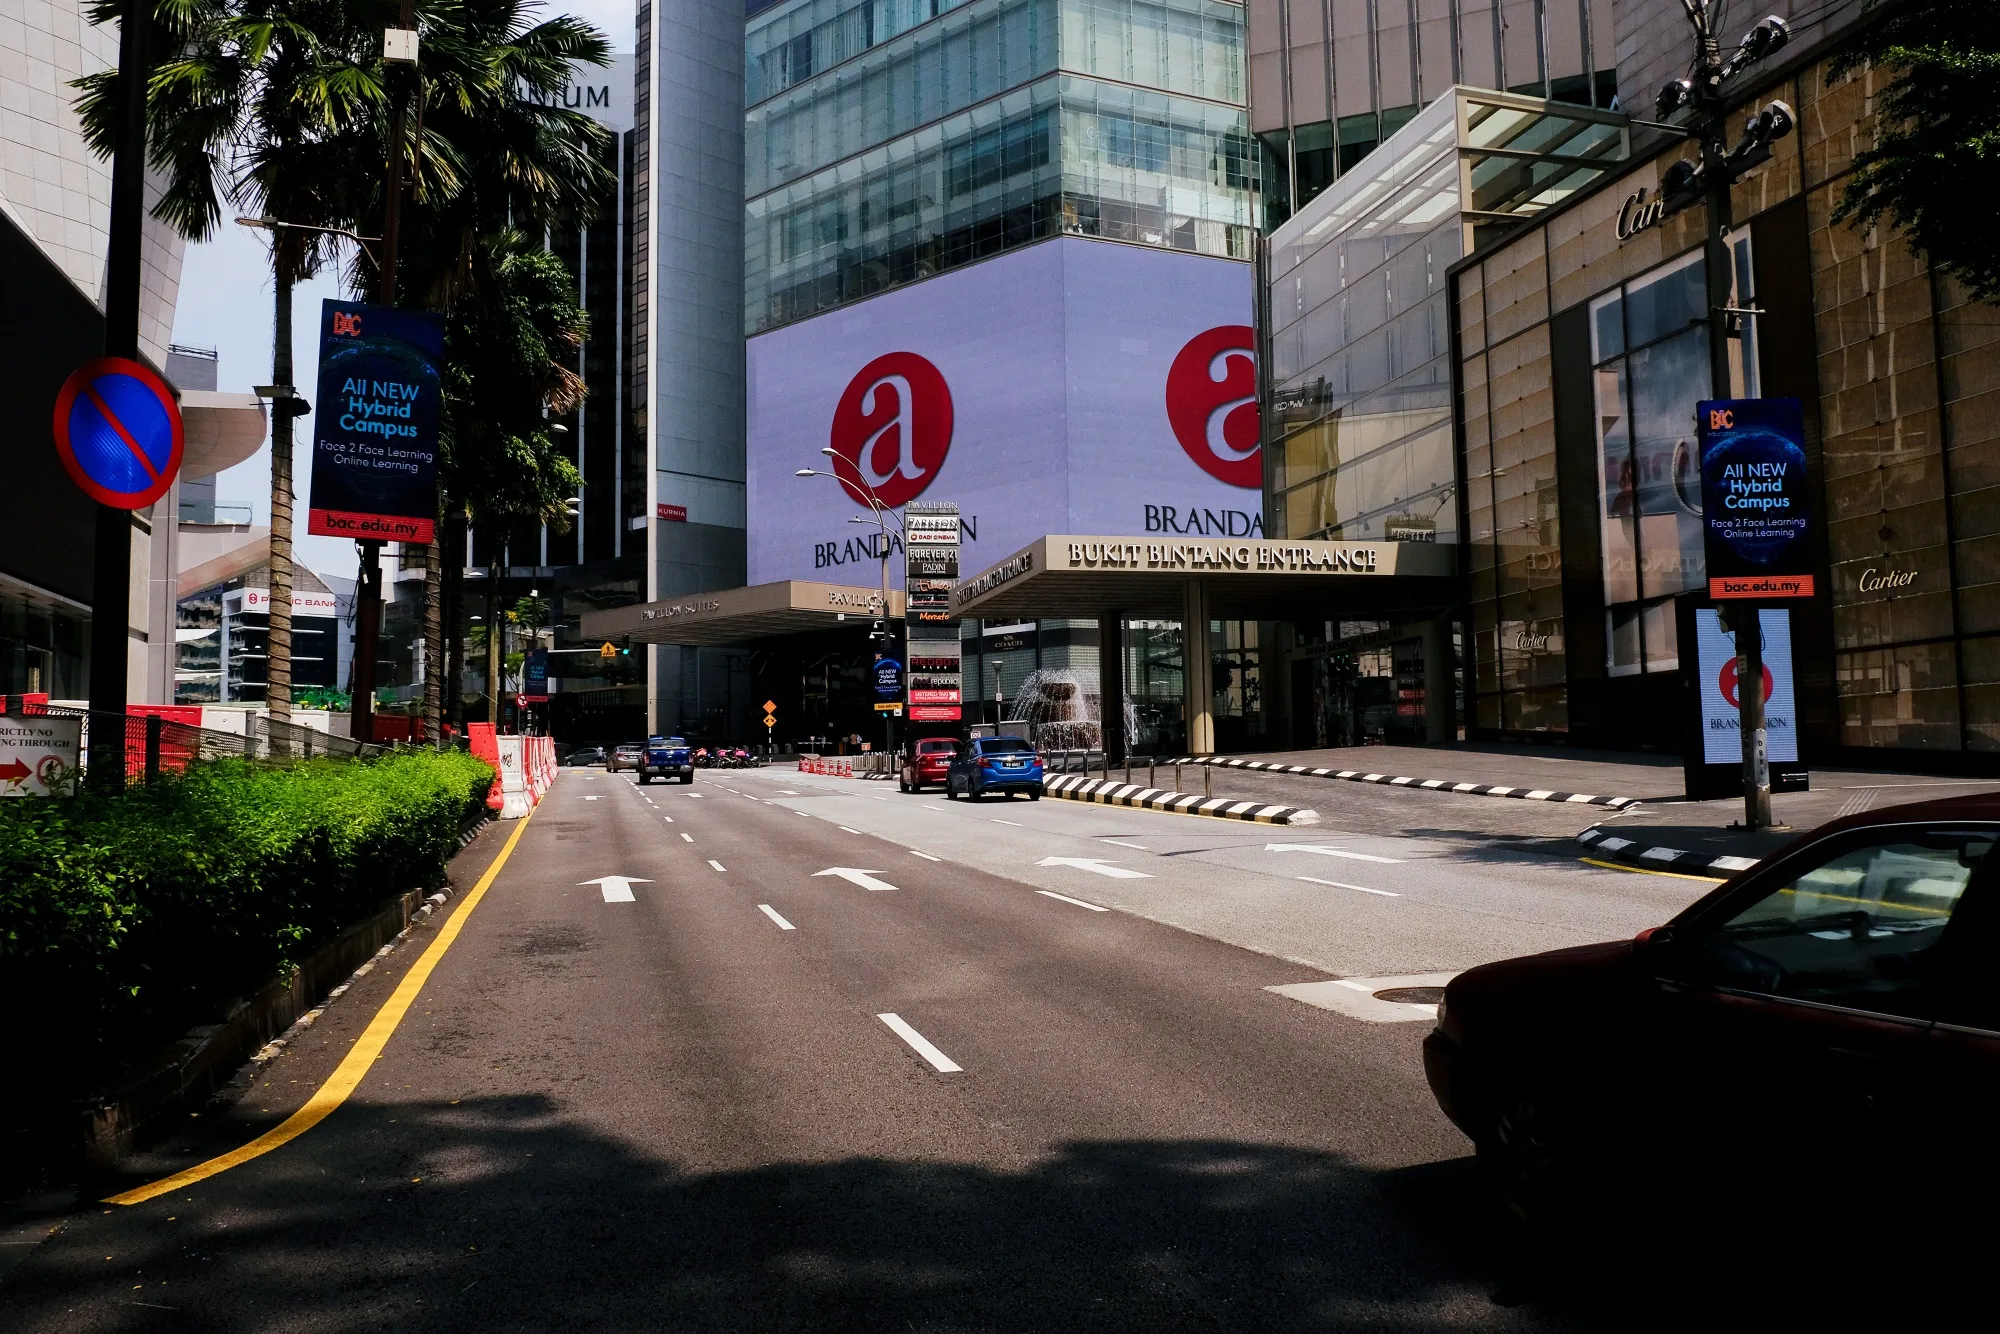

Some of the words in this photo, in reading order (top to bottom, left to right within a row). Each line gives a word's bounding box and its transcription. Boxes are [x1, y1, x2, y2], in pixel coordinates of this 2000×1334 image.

[342, 378, 366, 396] All
[372, 381, 419, 400] NEW
[349, 396, 411, 419] Hybrid
[340, 413, 418, 440] Campus
[320, 440, 346, 452] Face
[349, 443, 356, 452] 2
[358, 444, 384, 456] Face
[388, 447, 433, 463] Learning
[334, 454, 369, 467] Online
[372, 458, 418, 473] Learning
[1724, 464, 1743, 478] All
[1748, 463, 1787, 477] NEW
[1731, 478, 1782, 497] Hybrid
[908, 501, 958, 509] PAVILION
[1725, 495, 1790, 512] Campus
[658, 508, 686, 517] KURNIA
[326, 514, 418, 538] bac.edu.my
[908, 518, 957, 528] PARKSON
[1711, 519, 1733, 528] Face
[1735, 519, 1741, 527] 2
[1743, 518, 1764, 527] Face
[1767, 518, 1806, 528] Learning
[1724, 529, 1754, 538] Online
[1756, 528, 1795, 538] Learning
[910, 549, 946, 558] FOREVER
[949, 549, 958, 558] 21
[1070, 543, 1142, 563] BUKIT
[1149, 545, 1250, 566] BINTANG
[1258, 547, 1377, 567] ENTRANCE
[923, 563, 946, 571] PADINI
[996, 551, 1033, 585] ENTRANCE
[1724, 580, 1800, 594] bac.edu.my
[1859, 568, 1918, 593] Cartier
[305, 599, 337, 607] BANK
[641, 604, 682, 620] PAVILION
[685, 600, 719, 614] SUITES
[920, 611, 950, 620] Mercato
[995, 640, 1023, 648] COACH
[1516, 631, 1547, 649] Cartier
[911, 658, 958, 666] REDBOX
[37, 729, 53, 737] NO
[18, 739, 70, 748] THROUGH
